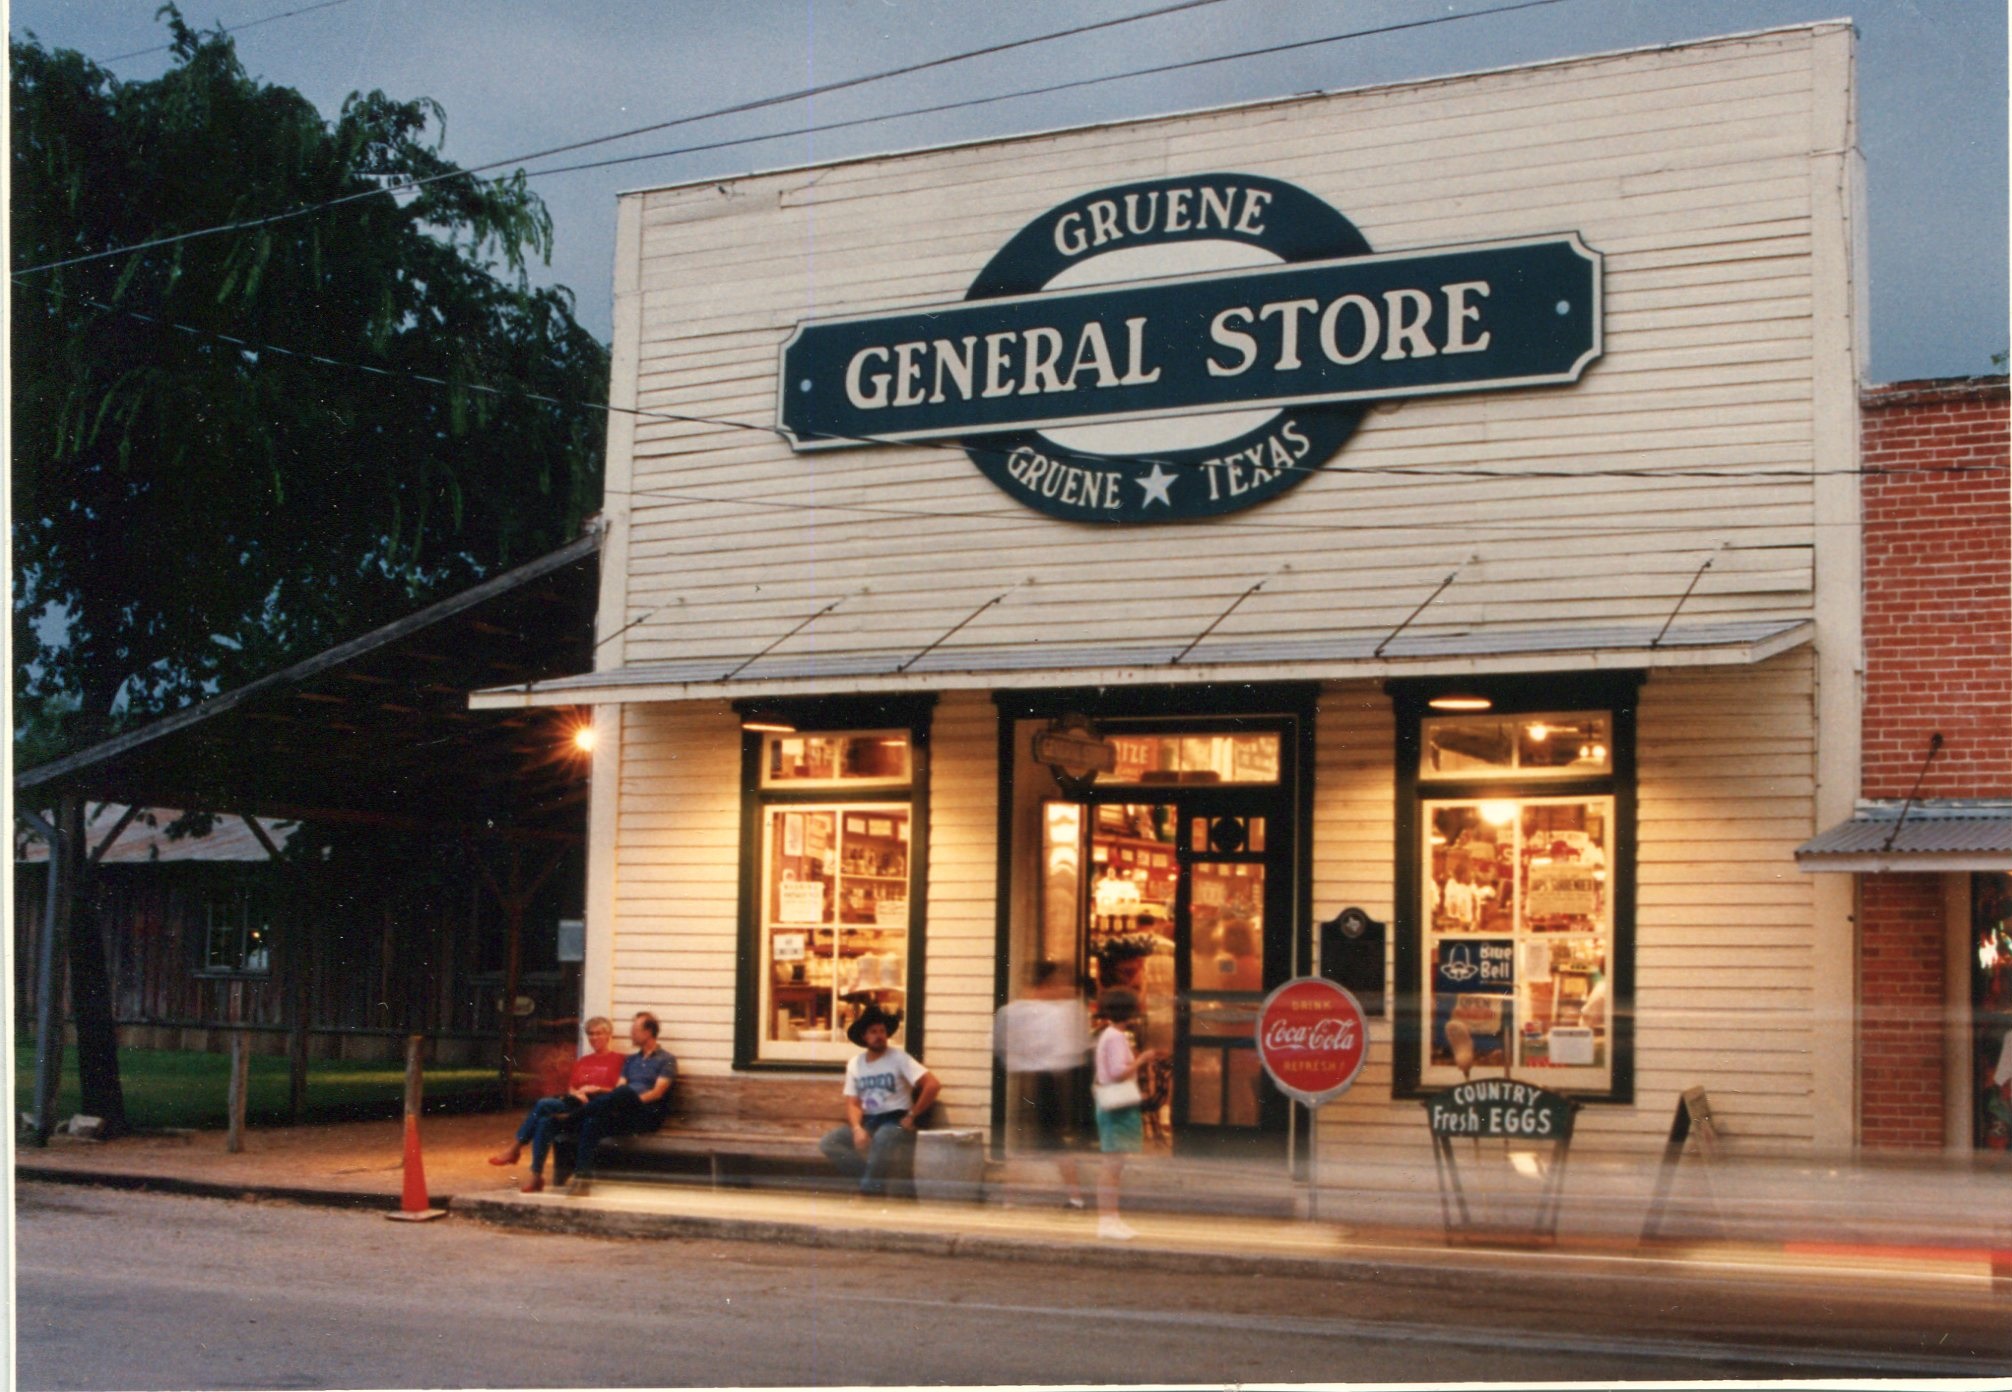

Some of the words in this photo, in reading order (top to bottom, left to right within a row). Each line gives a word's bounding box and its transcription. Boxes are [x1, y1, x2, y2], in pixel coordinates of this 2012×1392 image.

[1053, 186, 1273, 257] GRUENE
[844, 316, 1162, 410] GENERAL
[1205, 280, 1492, 377] STORE
[1007, 446, 1123, 509] GRUENE
[1200, 419, 1311, 500] TEXAS
[1481, 960, 1510, 978] Bell
[1291, 1000, 1332, 1010] DRINK
[1265, 1018, 1357, 1051] Coca-Cola
[1454, 1082, 1542, 1106] COUNTRY
[1433, 1105, 1479, 1131] Fresh
[1489, 1107, 1552, 1134] EGGS
